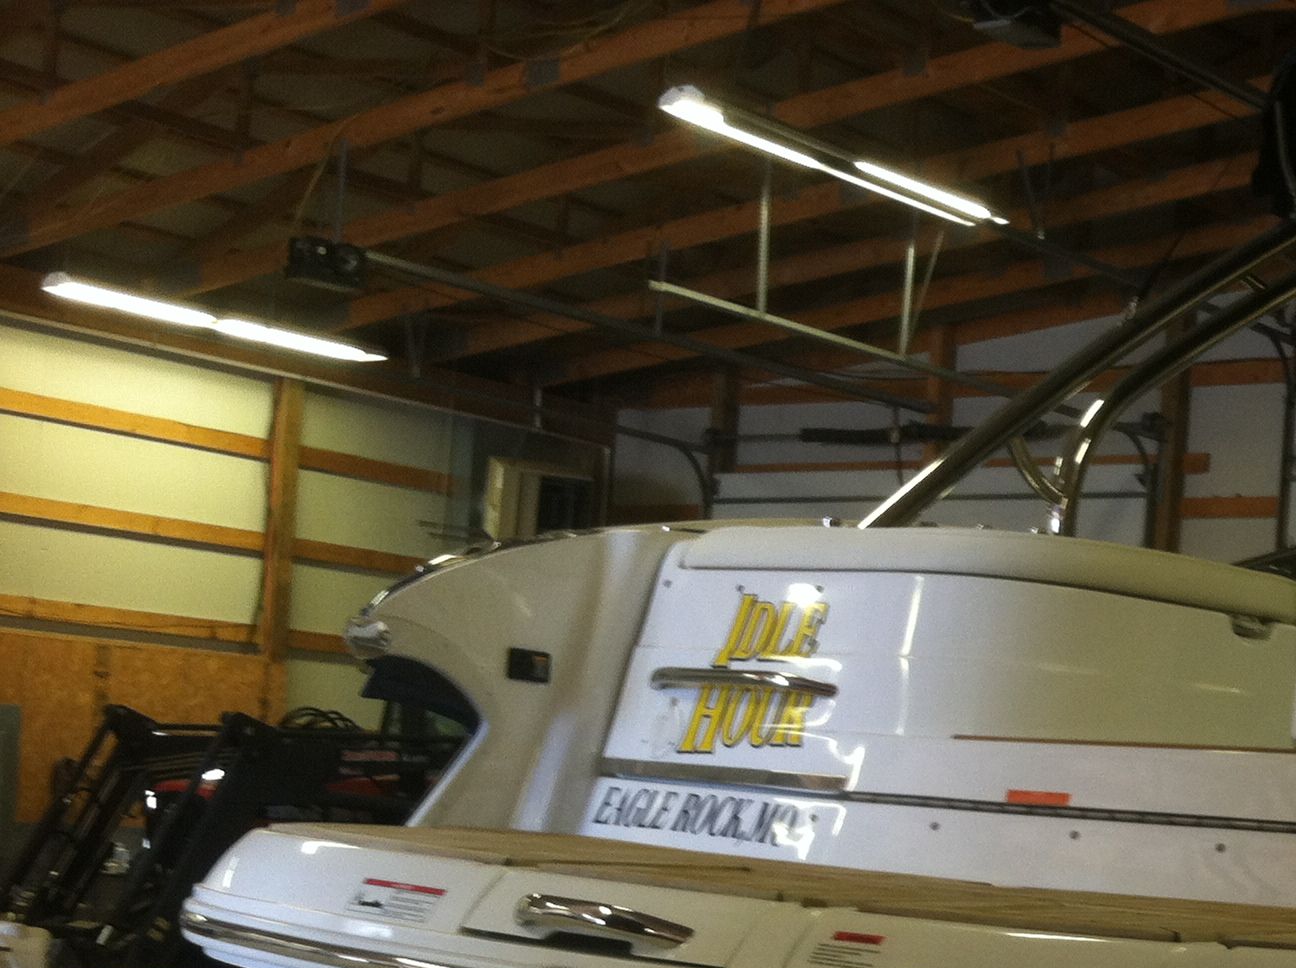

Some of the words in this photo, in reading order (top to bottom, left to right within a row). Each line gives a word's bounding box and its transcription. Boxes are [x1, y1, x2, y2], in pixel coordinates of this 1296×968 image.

[712, 593, 829, 669] IDLE
[676, 684, 814, 753] HOUR
[594, 788, 677, 829] EAGLE
